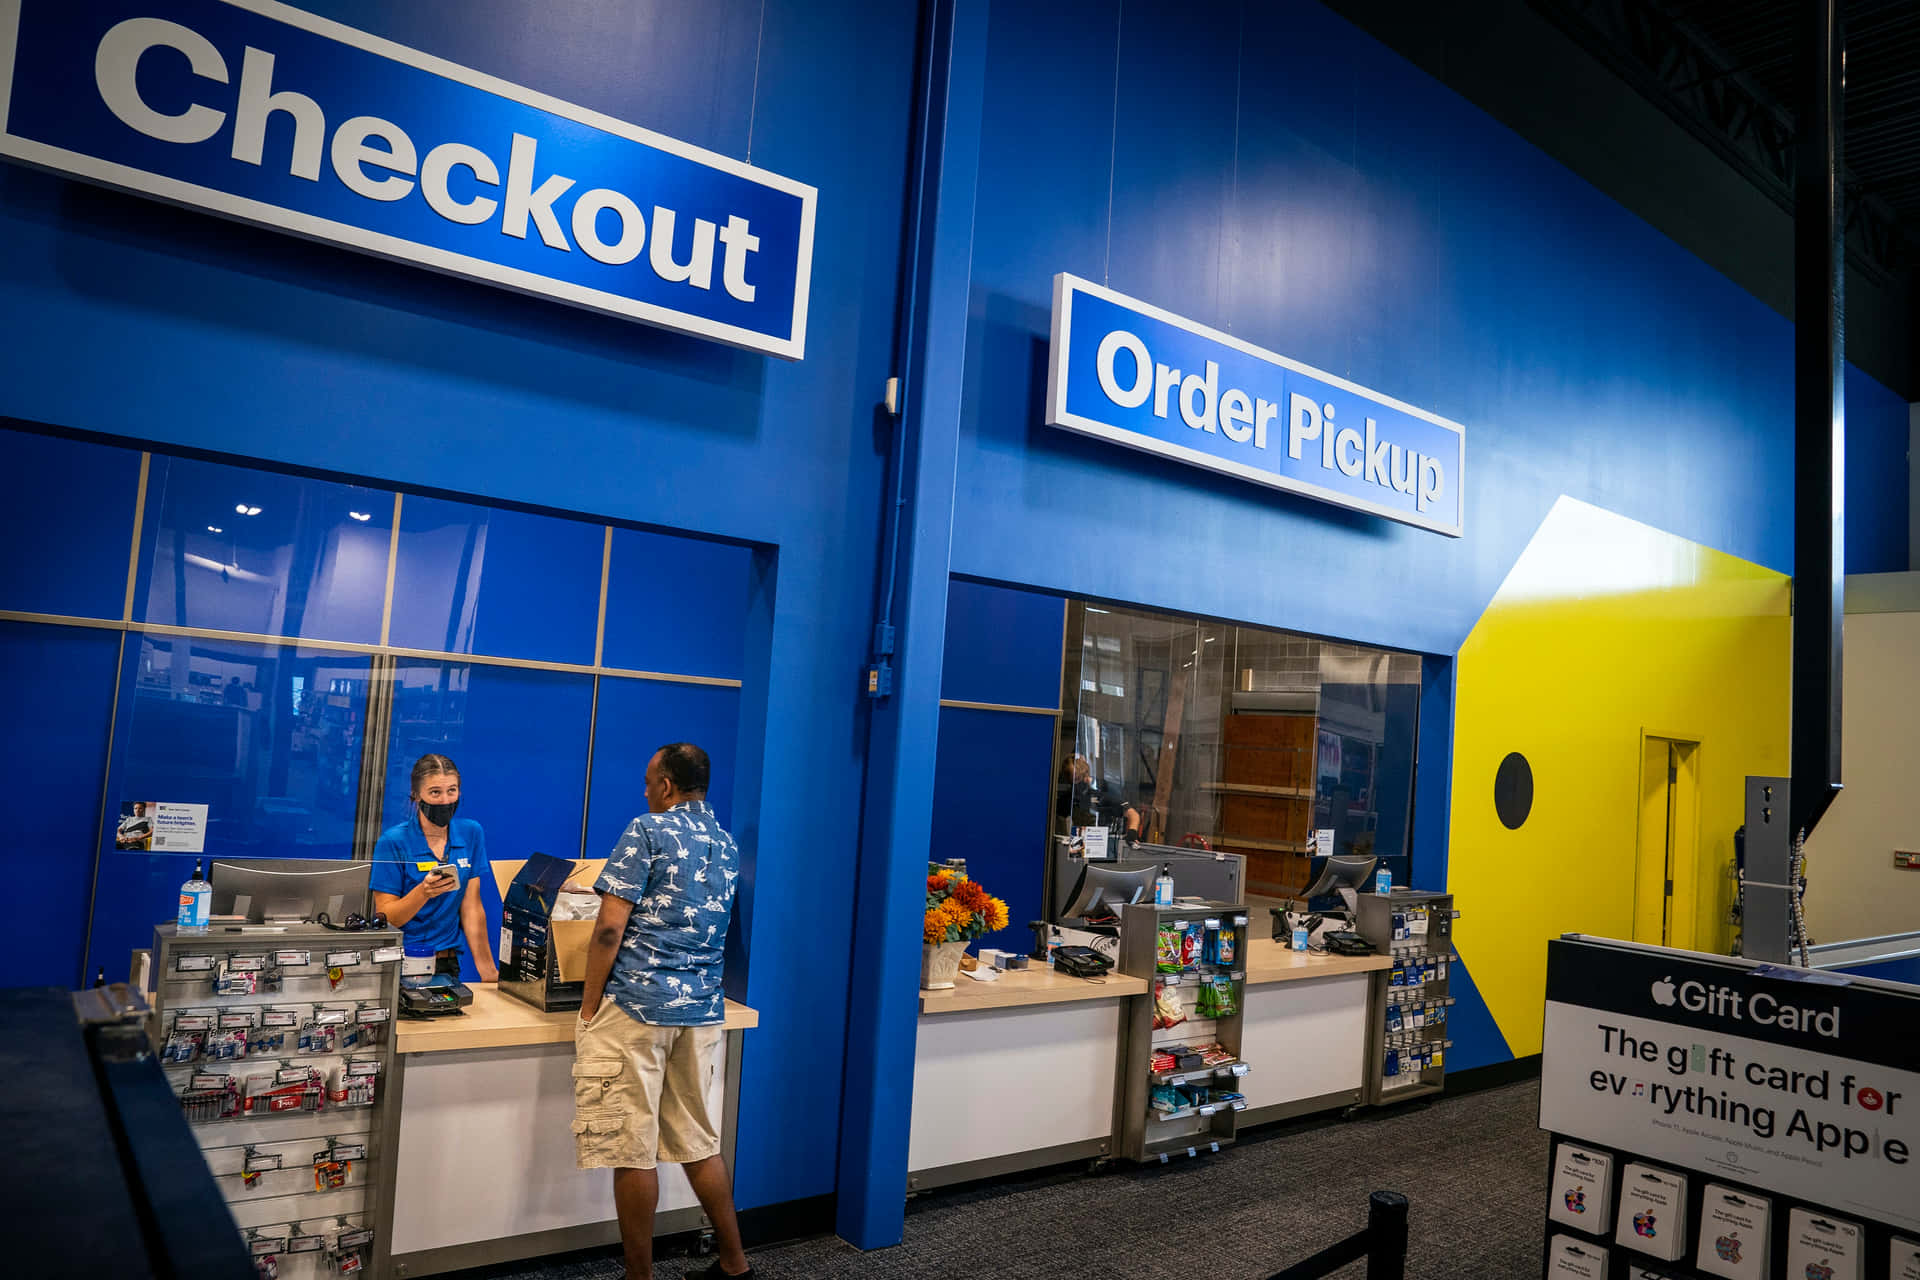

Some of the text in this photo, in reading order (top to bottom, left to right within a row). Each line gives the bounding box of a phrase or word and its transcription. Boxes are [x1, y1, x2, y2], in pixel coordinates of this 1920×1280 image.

[95, 17, 759, 302] Checkout
[1097, 330, 1444, 512] Order Pickup
[1680, 980, 1841, 1039] Gift Card
[1589, 1069, 1775, 1138] evrything
[1598, 1024, 1902, 1115] The gft card fr
